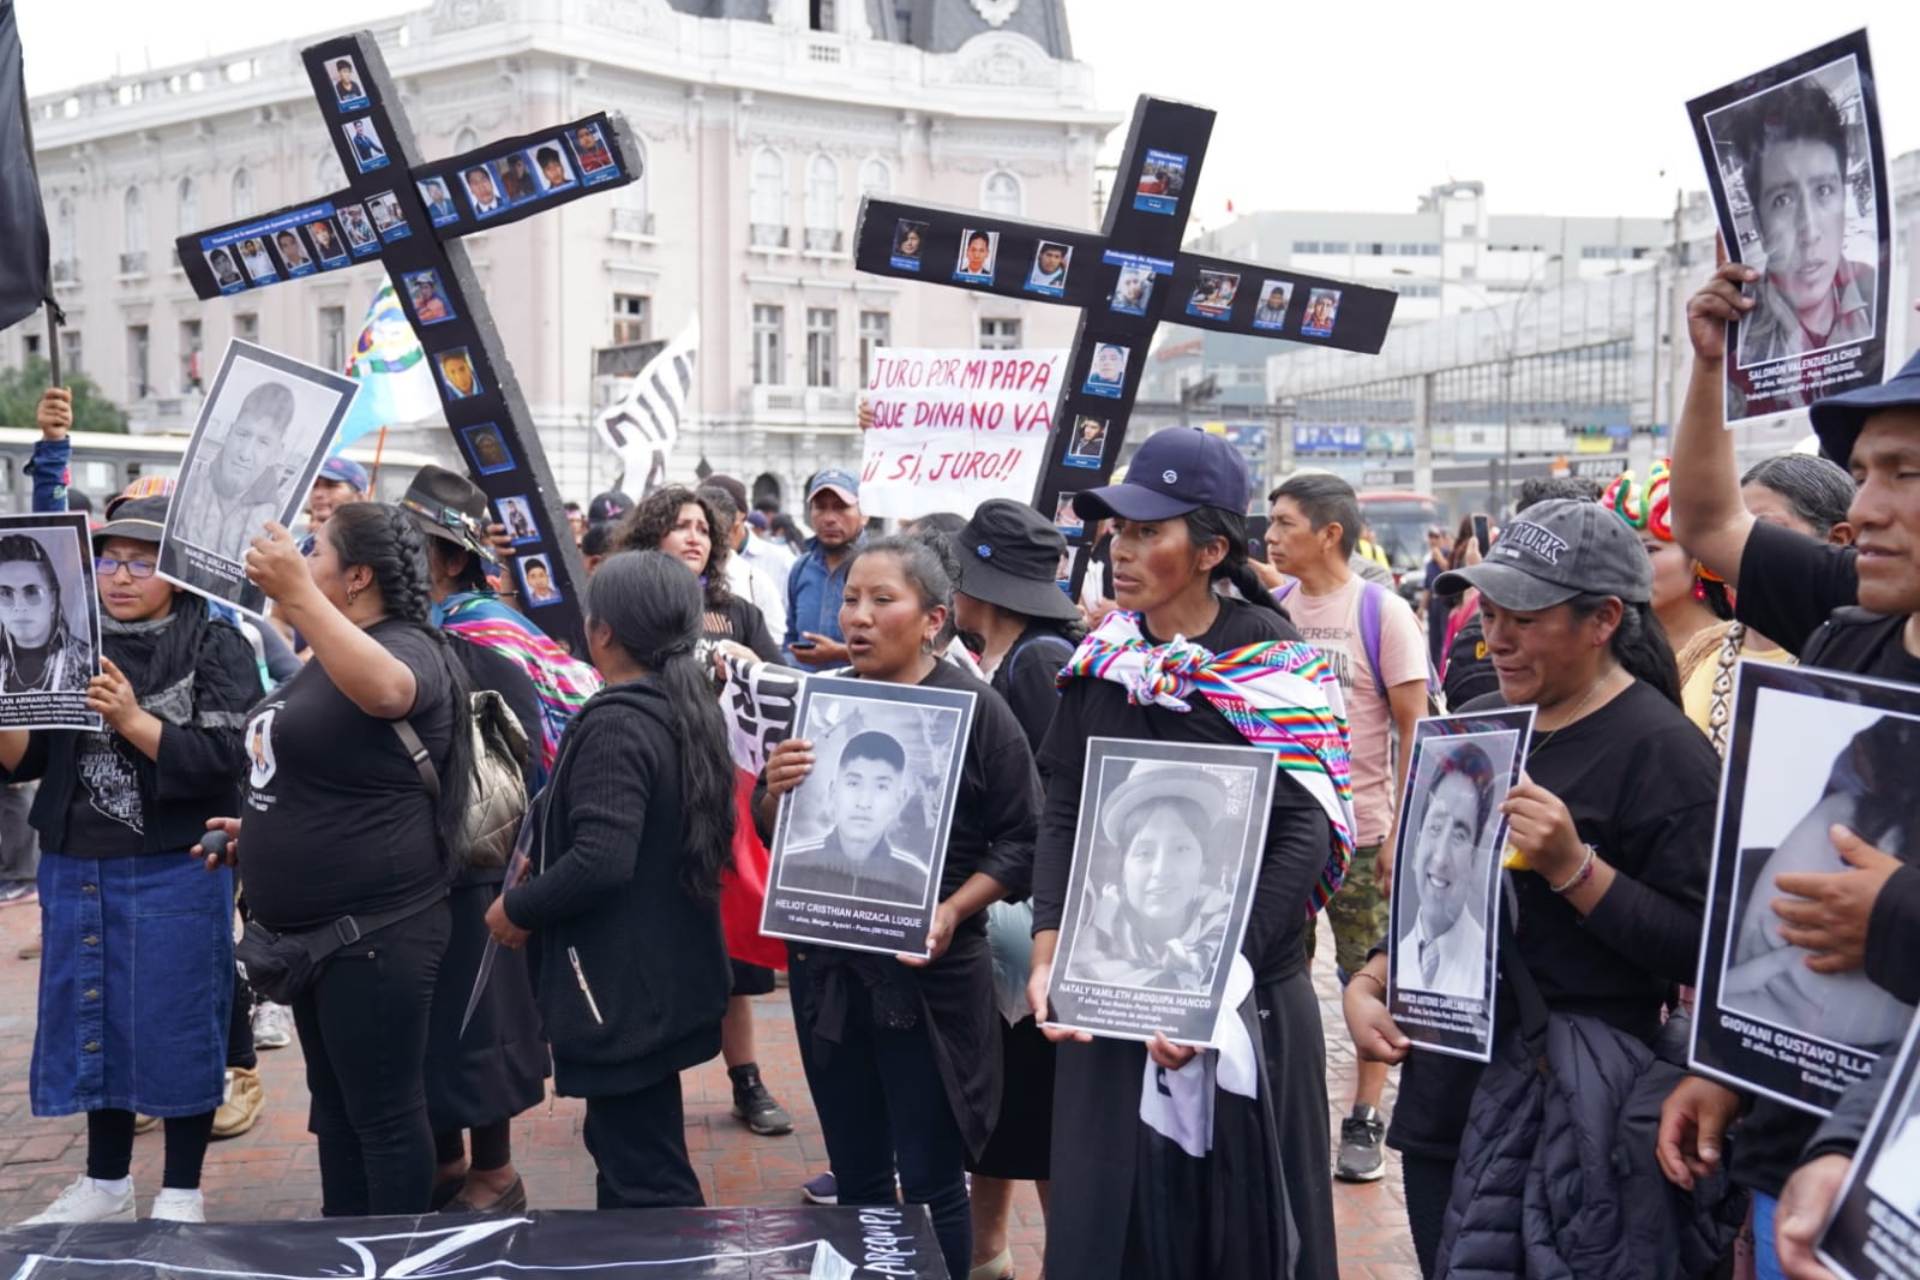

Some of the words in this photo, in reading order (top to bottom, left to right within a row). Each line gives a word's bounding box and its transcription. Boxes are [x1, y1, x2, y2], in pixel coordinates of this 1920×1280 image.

[870, 358, 923, 391] JURO
[926, 358, 960, 388] POR
[961, 359, 987, 389] MI
[990, 354, 1058, 393] PAPÁ
[1787, 351, 1838, 374] VALENZUELA
[872, 401, 907, 429] QUE
[914, 401, 964, 428] DINA
[970, 401, 1004, 431] NO
[1014, 401, 1055, 432] VA
[775, 899, 805, 913] HELIOT
[807, 903, 851, 919] CRISTHIAN
[852, 908, 890, 923] ARIZACA
[892, 914, 922, 928] LUQUE
[1058, 983, 1090, 994] NATALY
[1091, 986, 1131, 999] YAMILETH
[1175, 997, 1212, 1009] HANCCO
[1720, 1015, 1772, 1042] GIOVANI
[1774, 1033, 1836, 1062] GUSTAVO
